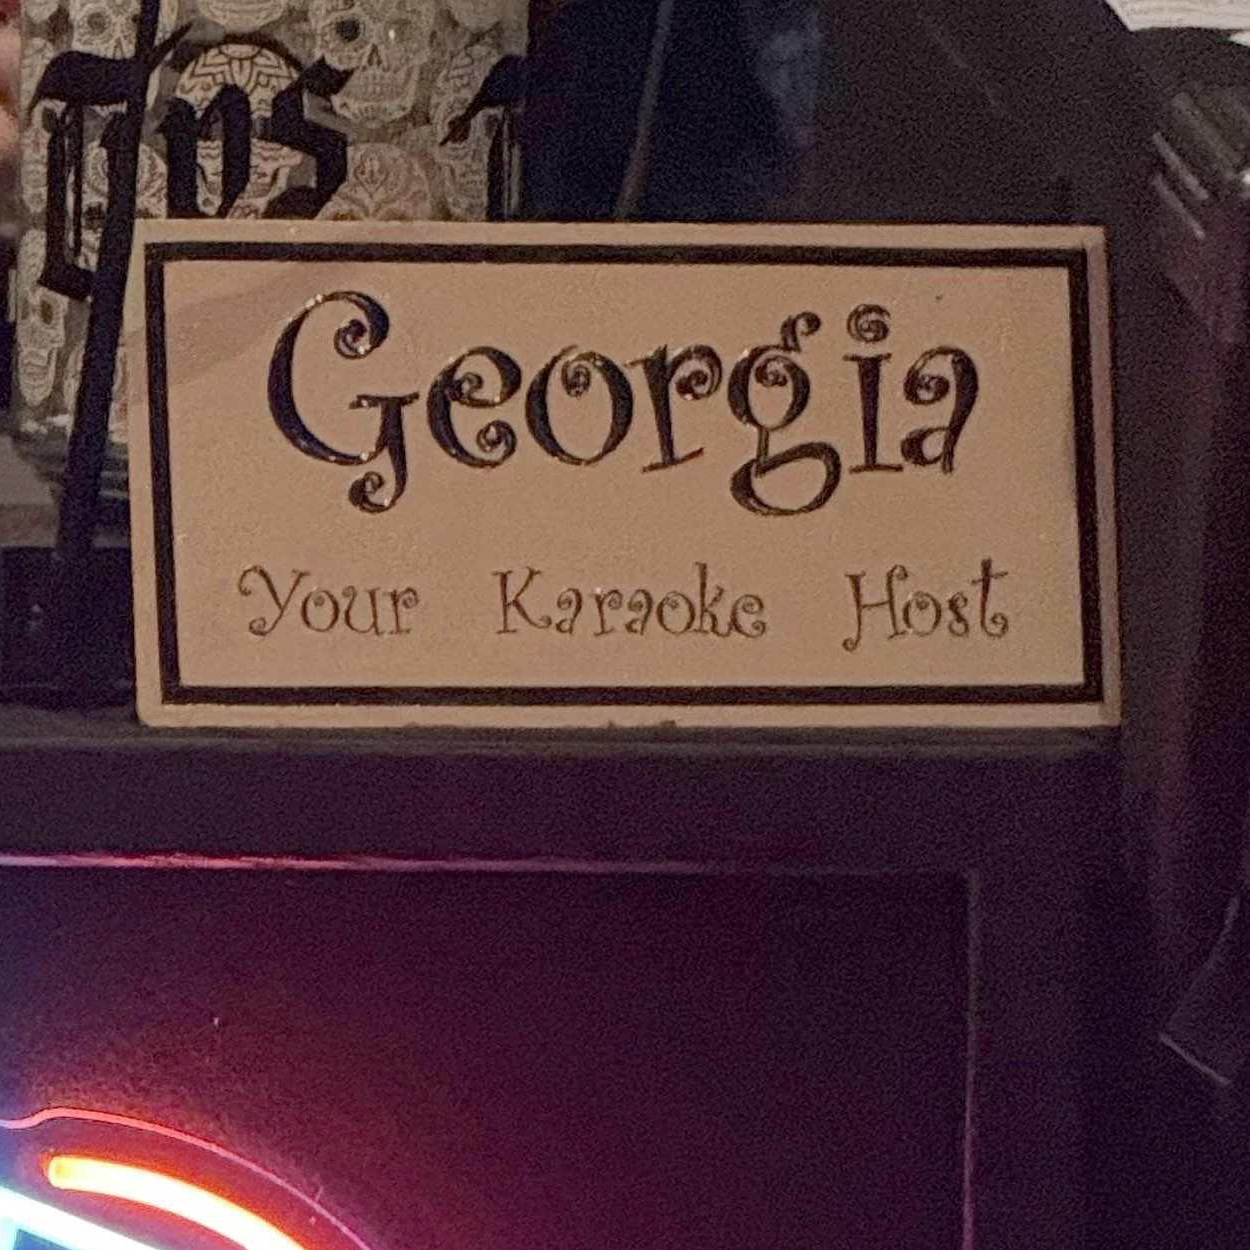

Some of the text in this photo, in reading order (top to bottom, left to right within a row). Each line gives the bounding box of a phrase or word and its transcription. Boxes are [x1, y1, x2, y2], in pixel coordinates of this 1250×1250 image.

[29, 25, 353, 302] Tps
[266, 289, 980, 517] Georgia
[236, 556, 1011, 653] Your Karaoke Host
